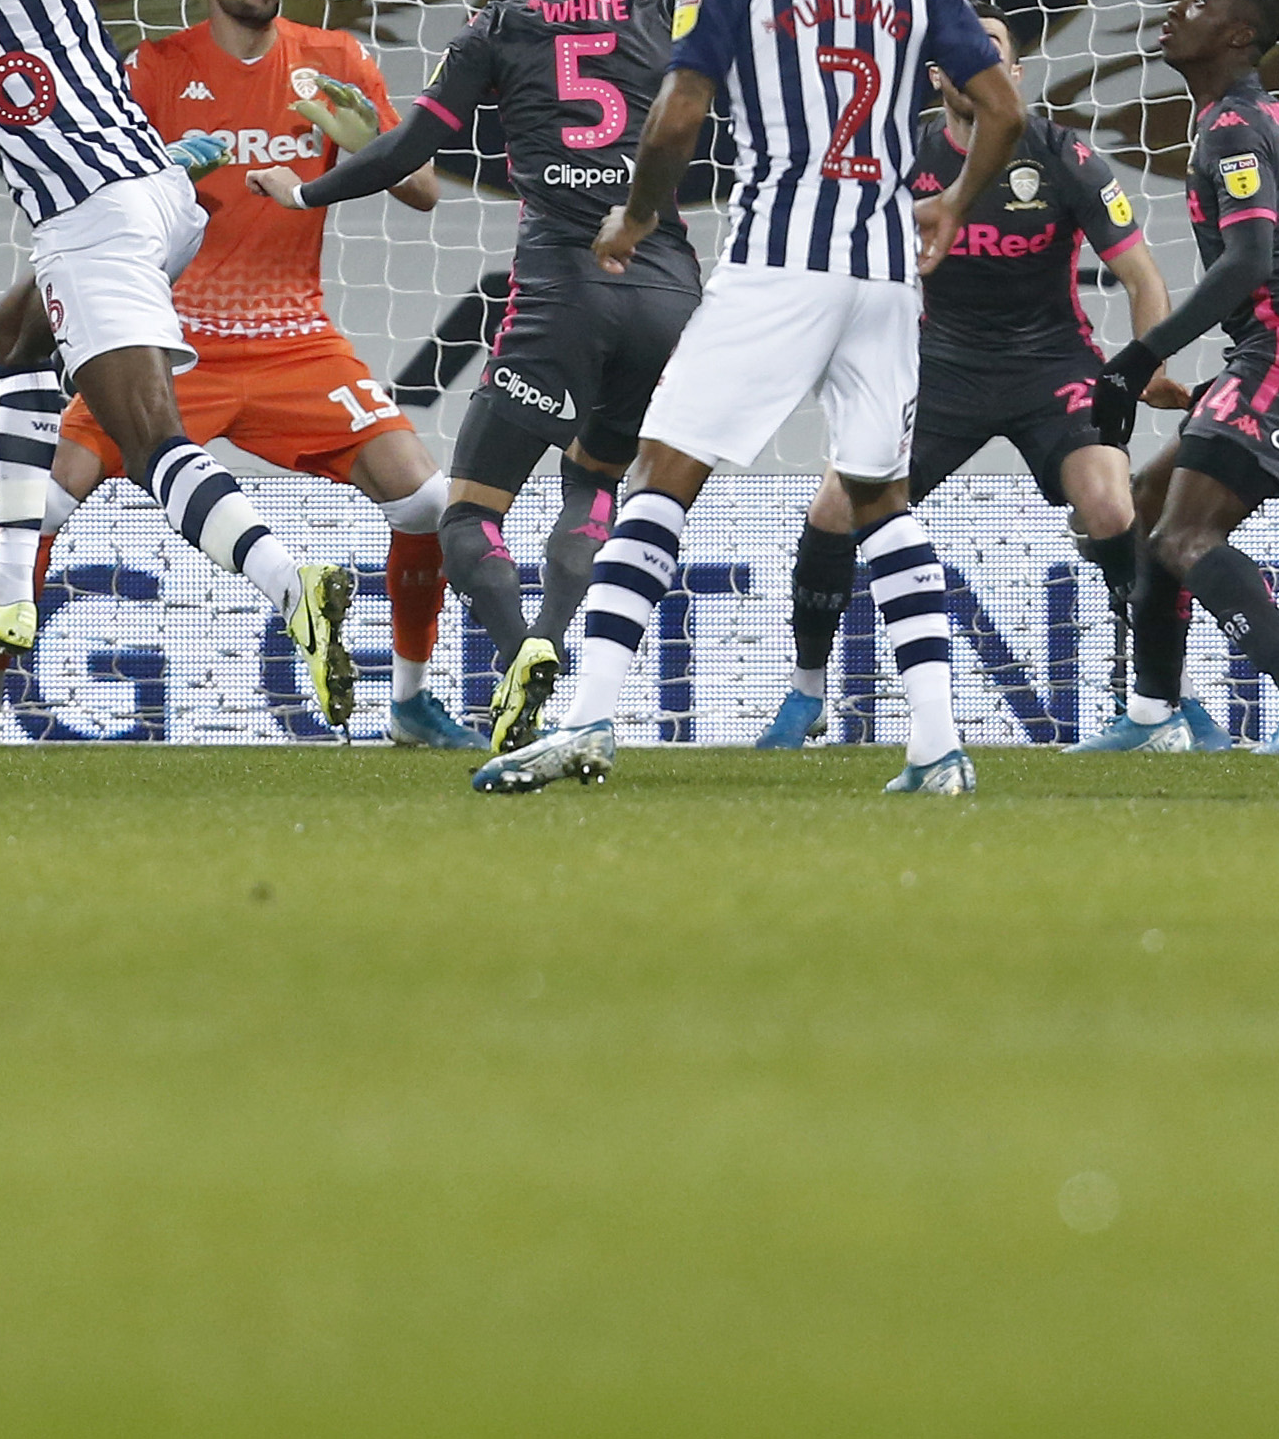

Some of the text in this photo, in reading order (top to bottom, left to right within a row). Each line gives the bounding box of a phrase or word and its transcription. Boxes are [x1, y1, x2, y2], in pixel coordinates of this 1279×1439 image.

[554, 32, 629, 150] 5
[817, 45, 882, 181] 2
[182, 123, 323, 166] 2Red
[1222, 159, 1256, 172] sky bet
[543, 163, 625, 189] Clipper
[947, 221, 1057, 258] 2Red
[46, 281, 65, 335] 6
[327, 378, 401, 433] 13
[493, 366, 563, 415] Clipper
[31, 420, 58, 434] WB
